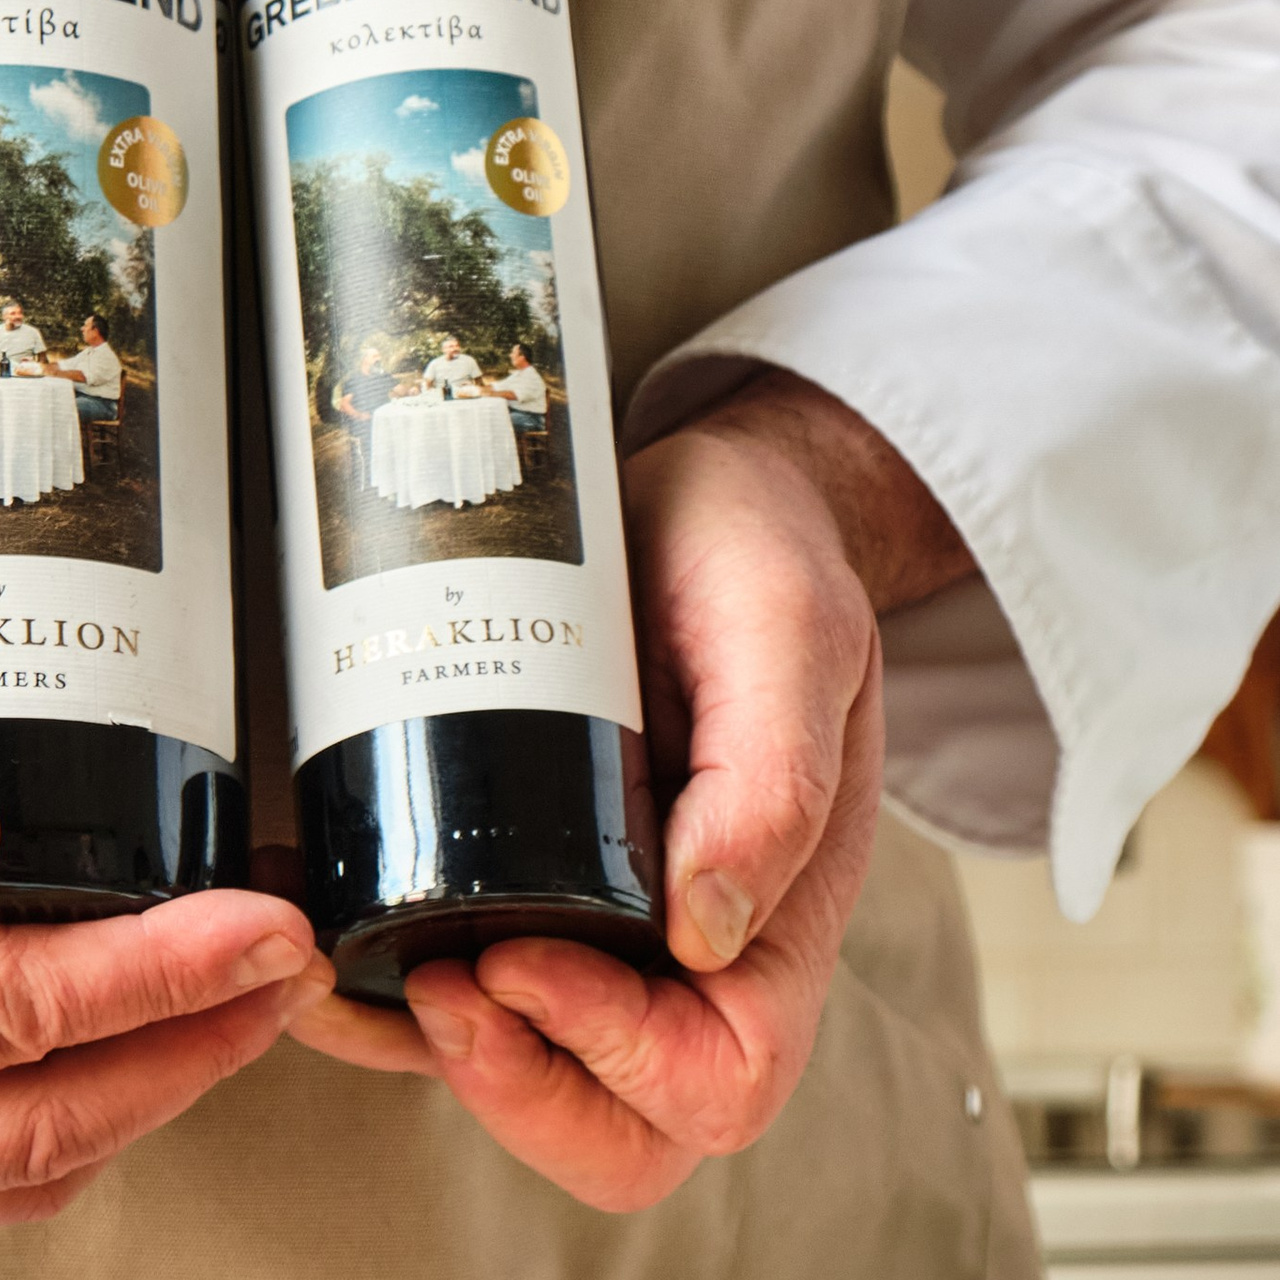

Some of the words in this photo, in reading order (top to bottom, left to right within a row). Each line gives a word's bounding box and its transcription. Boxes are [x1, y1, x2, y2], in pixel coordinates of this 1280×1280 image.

[329, 14, 484, 56] κολεκτίβα
[109, 126, 144, 169] EXTRA
[494, 126, 527, 166] EXTRA
[444, 586, 465, 606] by
[333, 617, 586, 674] HERAKLION
[401, 659, 523, 686] FARMERS
